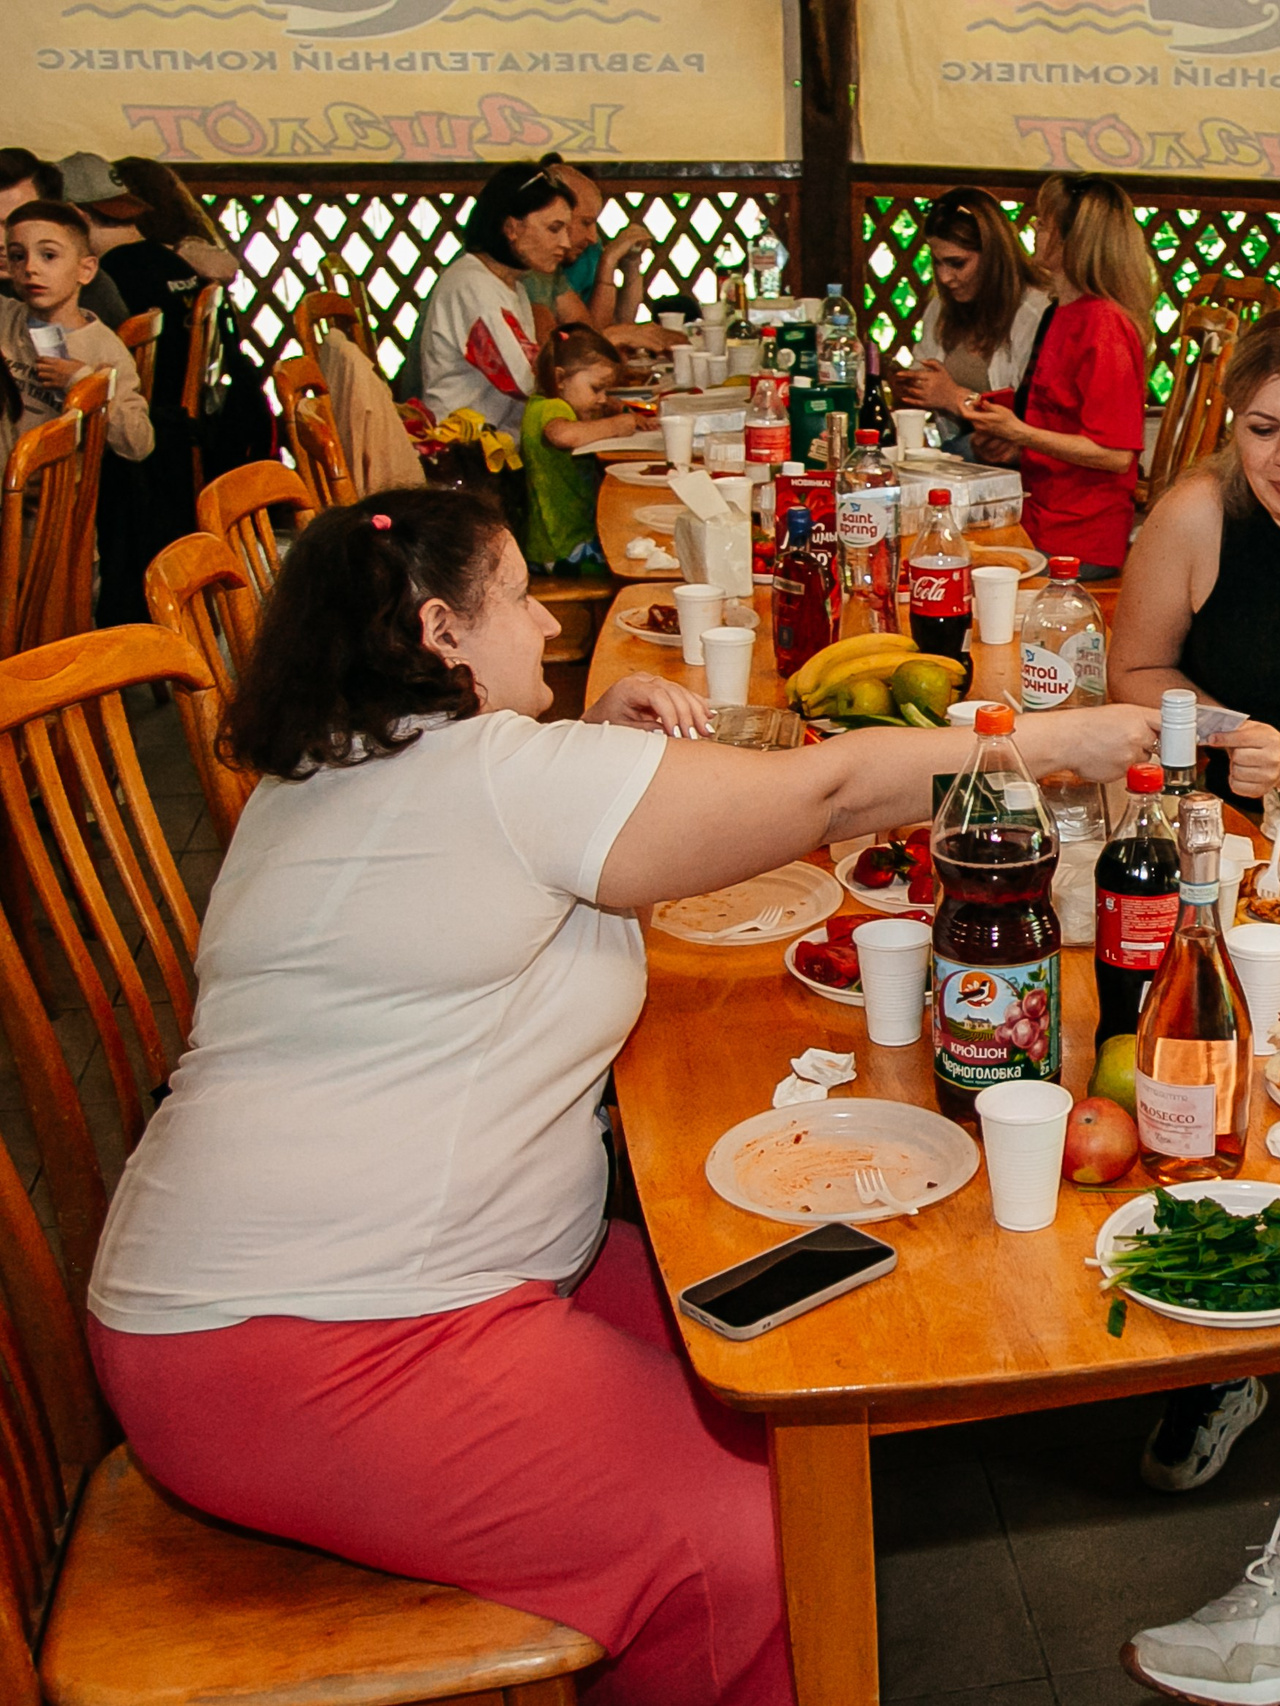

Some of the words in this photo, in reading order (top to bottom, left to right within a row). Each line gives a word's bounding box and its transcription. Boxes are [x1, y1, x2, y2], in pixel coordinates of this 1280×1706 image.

[842, 512, 874, 524] saint
[840, 522, 878, 538] spring
[950, 1041, 1008, 1059] КРЮШОН
[1140, 1100, 1196, 1124] PROSECCO
